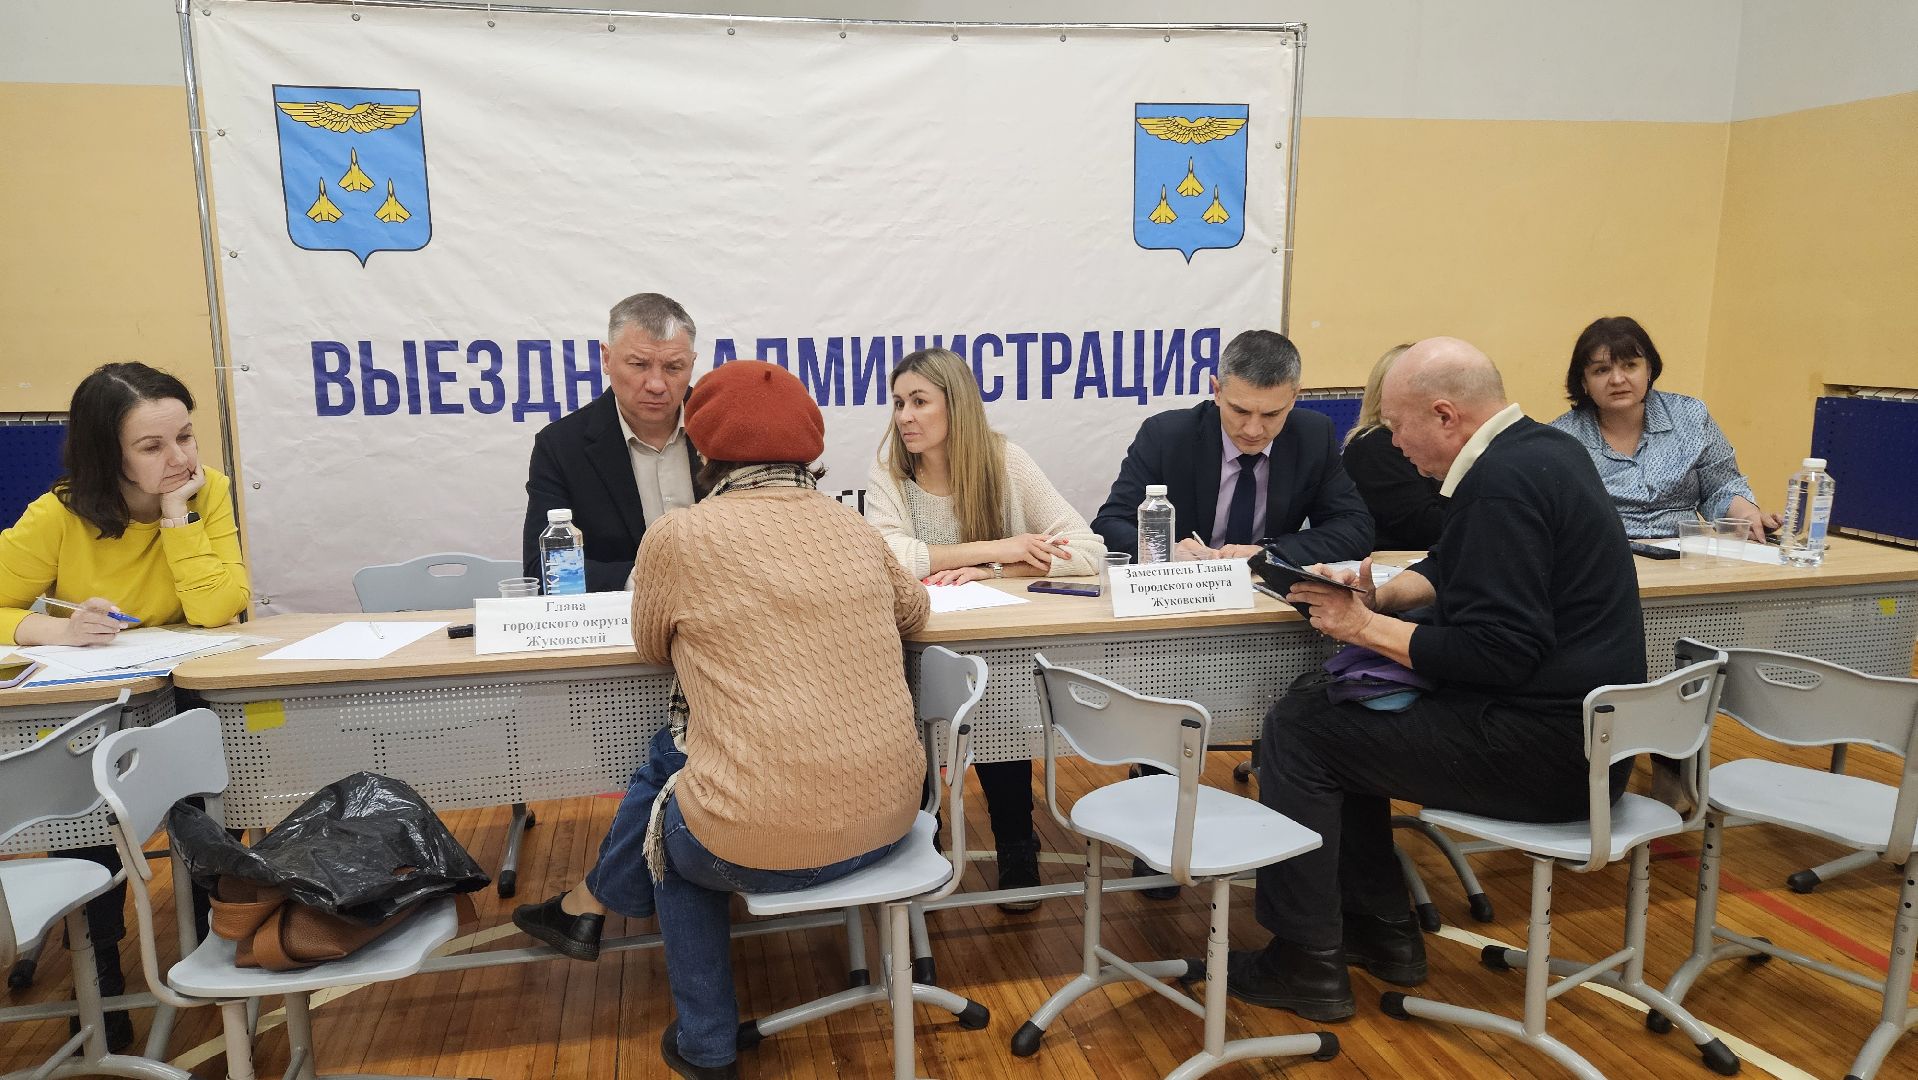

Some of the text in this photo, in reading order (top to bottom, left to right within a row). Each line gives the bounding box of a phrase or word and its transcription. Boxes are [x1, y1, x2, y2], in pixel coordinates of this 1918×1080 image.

[311, 327, 1221, 423] ВЫЕЗДН МИСТРАЦИЯ
[1125, 563, 1232, 579] Заместитель Главы
[1130, 578, 1232, 596] Городского округа
[546, 601, 586, 612] Глава
[1151, 594, 1216, 609] Жуковский
[503, 617, 629, 634] городского округа
[526, 633, 606, 648] Жуковский
